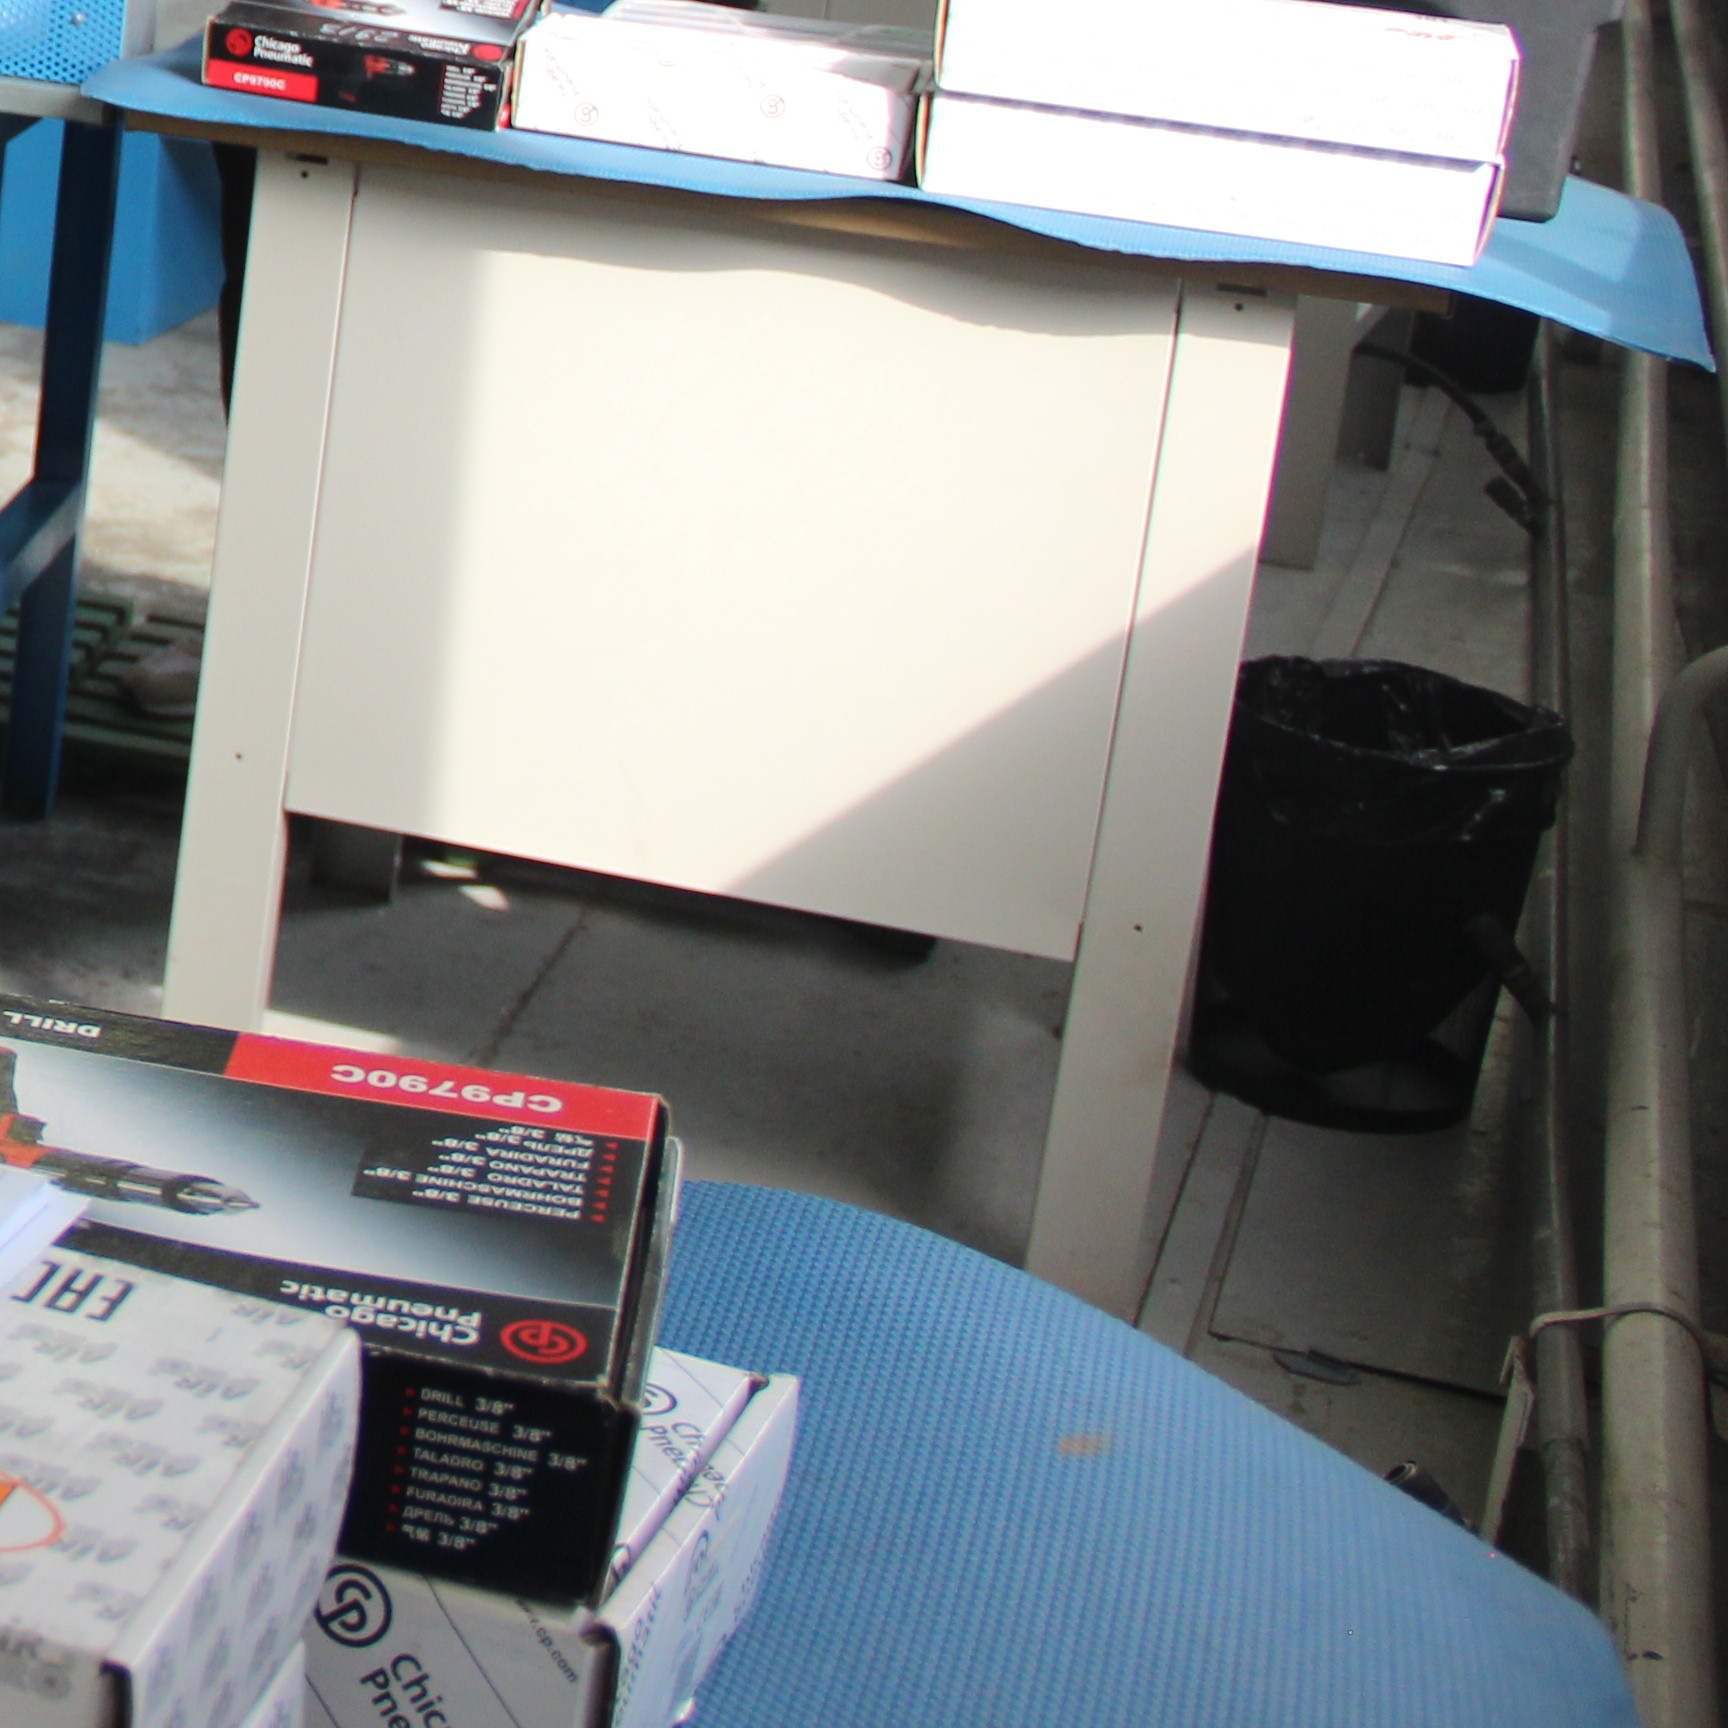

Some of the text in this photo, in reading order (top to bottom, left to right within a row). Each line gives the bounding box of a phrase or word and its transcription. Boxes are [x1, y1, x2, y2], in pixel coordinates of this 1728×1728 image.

[254, 35, 301, 54] Chicago
[254, 46, 314, 67] Pneumatic
[4, 1010, 101, 1038] DRILL
[329, 1063, 562, 1113] CP9790C
[486, 1147, 591, 1170] FURADIRA
[489, 1160, 588, 1182] TRAPANO
[415, 1174, 584, 1207] BOHRMASCHINE
[487, 1172, 586, 1194] TALADRO
[467, 1194, 582, 1220] PERCEUSE
[279, 1280, 482, 1328] Pneumatic
[325, 1305, 480, 1345] Chicago
[421, 1388, 464, 1407] DRILL
[418, 1408, 500, 1434] PERCEUSE
[415, 1428, 538, 1462] BOHRMASCHINE
[413, 1447, 484, 1471] TALADRO
[410, 1467, 481, 1491] TRAPANO
[406, 1486, 484, 1511] FURADIRA
